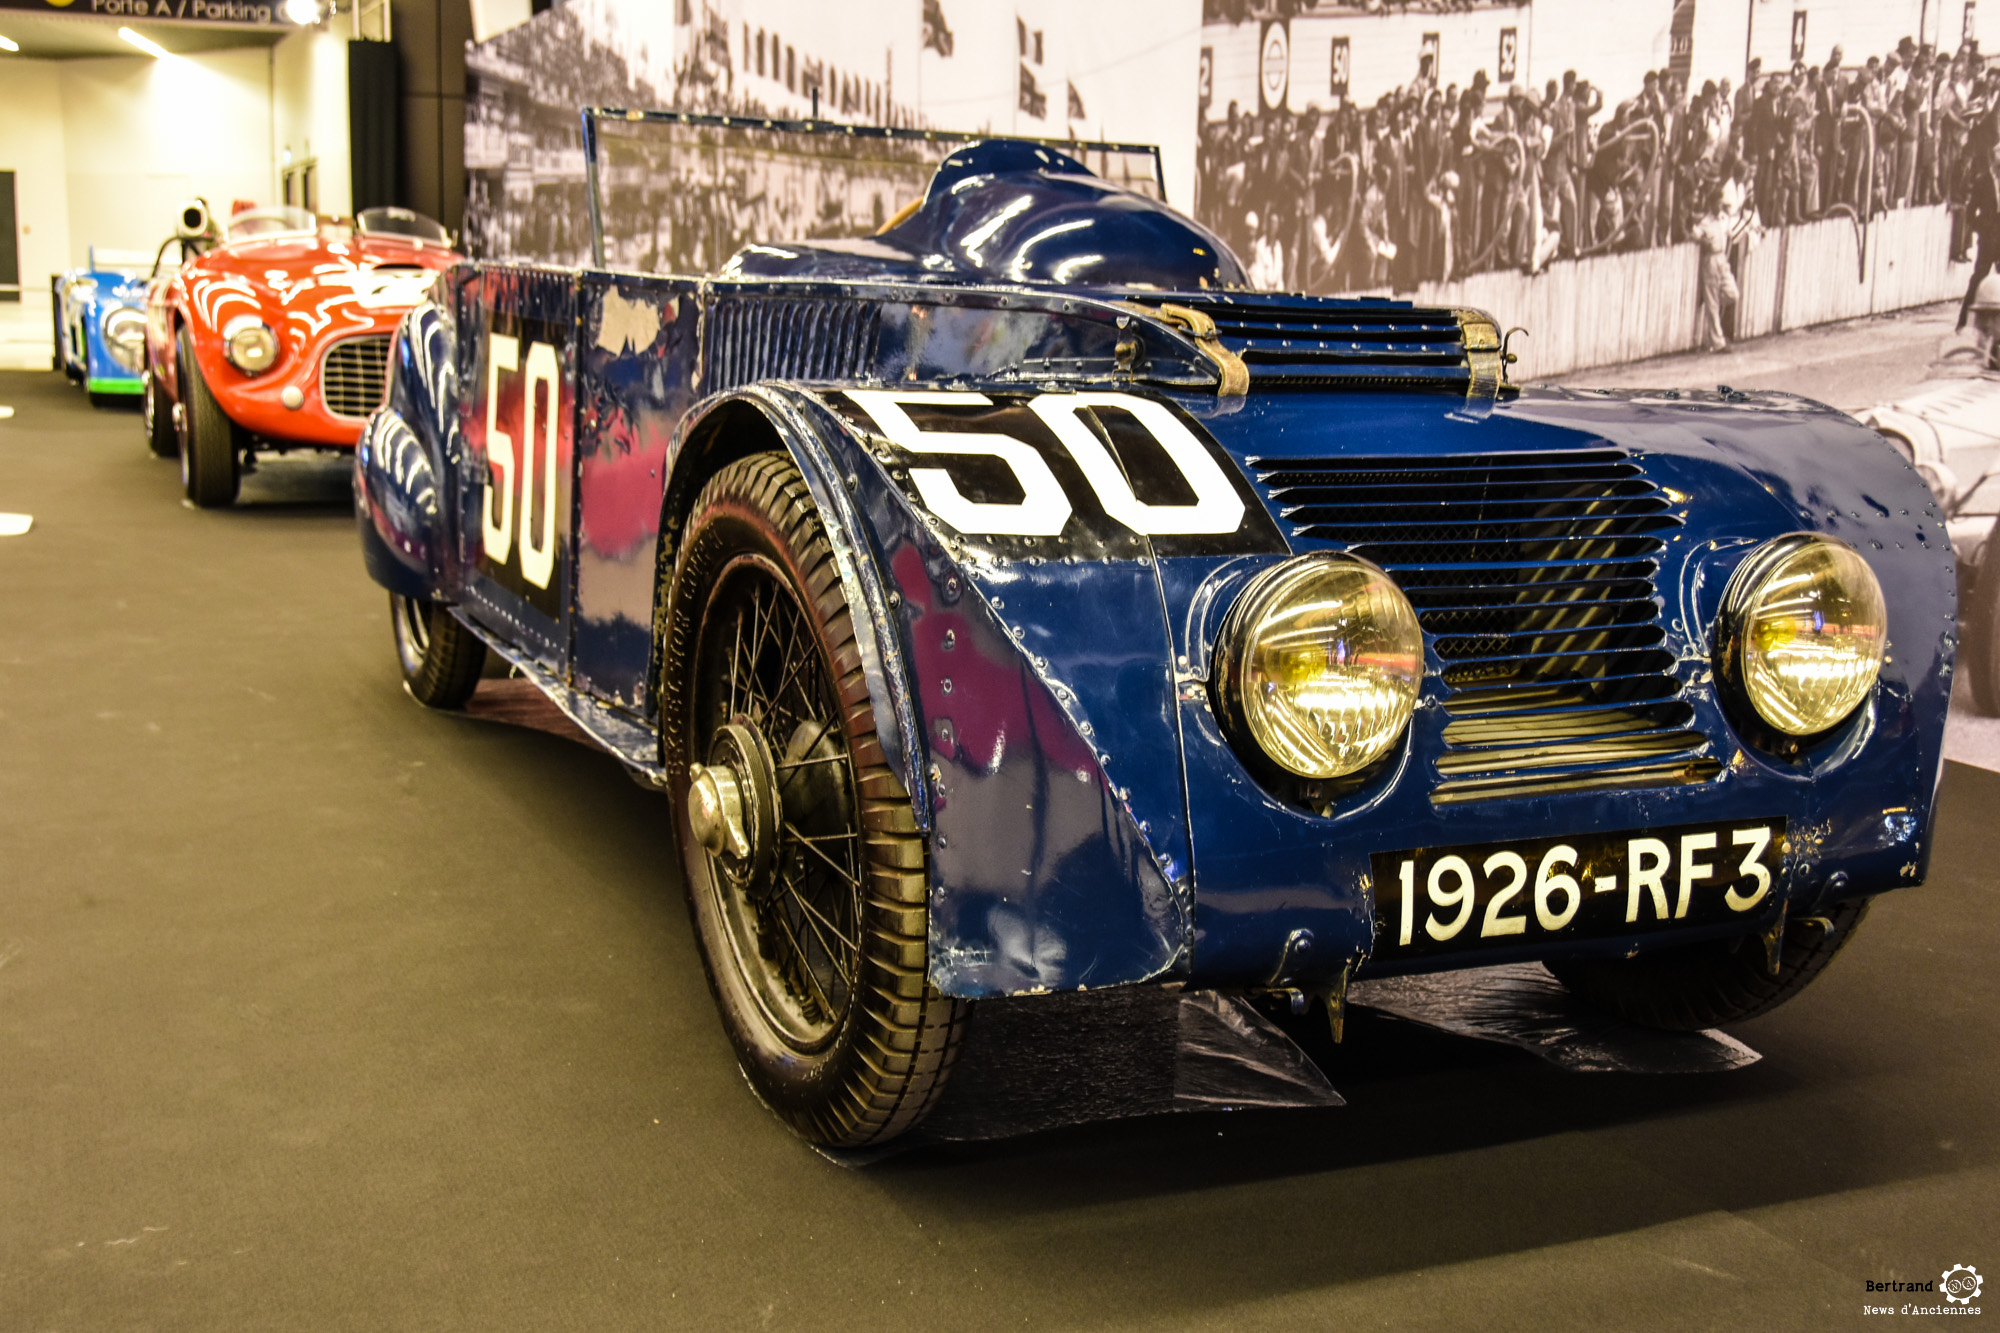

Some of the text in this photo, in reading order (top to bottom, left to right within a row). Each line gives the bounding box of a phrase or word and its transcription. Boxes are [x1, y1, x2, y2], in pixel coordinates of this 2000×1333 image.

[91, 0, 149, 16] Porte
[154, 0, 172, 17] A
[192, 0, 272, 25] Parking
[1333, 45, 1349, 85] 50
[482, 332, 559, 590] 50
[842, 390, 1246, 536] 50
